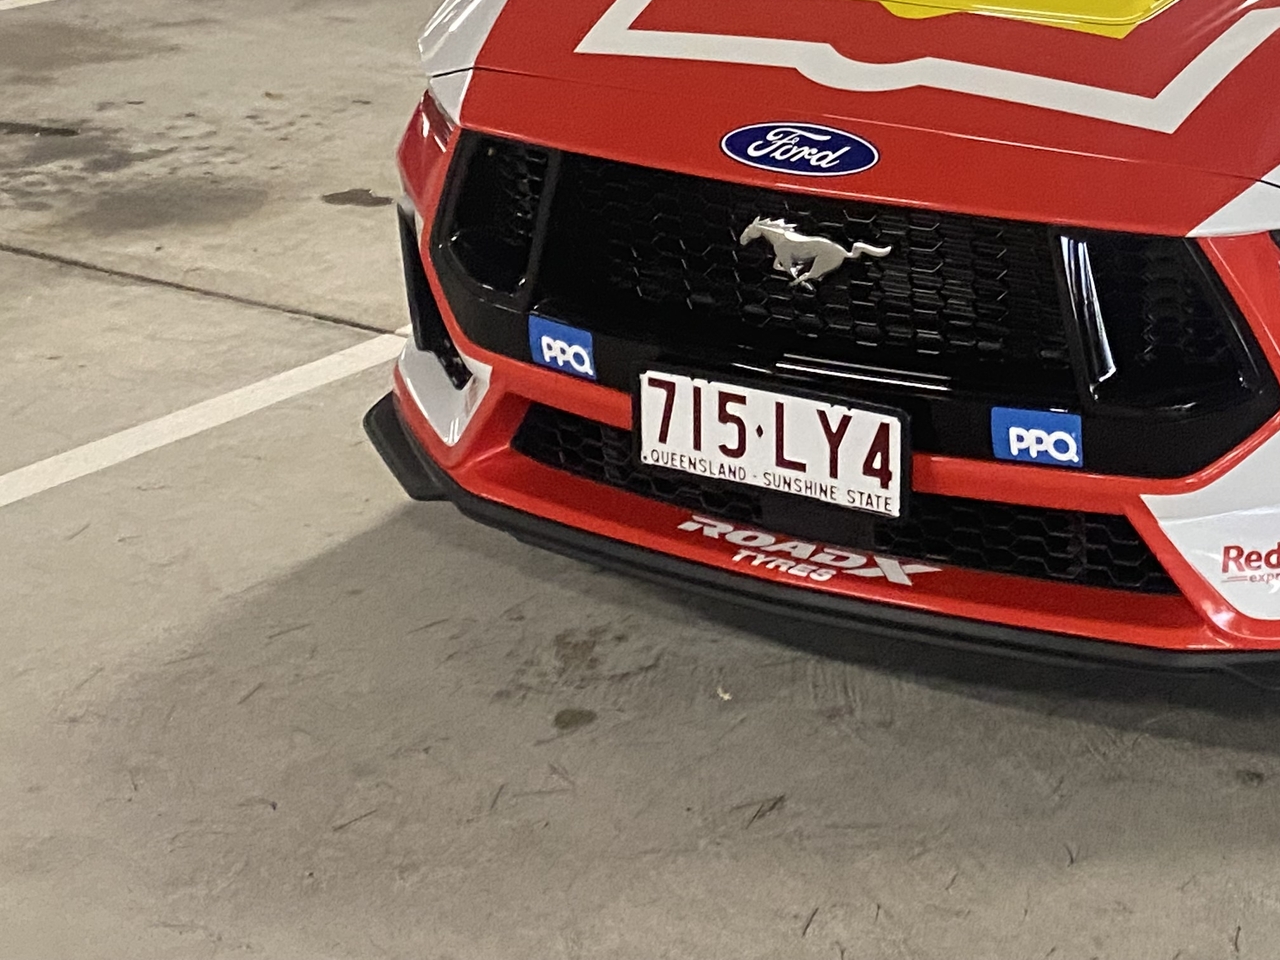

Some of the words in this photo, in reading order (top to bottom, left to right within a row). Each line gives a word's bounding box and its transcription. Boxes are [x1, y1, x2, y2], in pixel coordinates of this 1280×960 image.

[747, 127, 852, 168] Ford
[541, 335, 594, 376] PPQ
[1009, 426, 1080, 463] PPQ
[650, 448, 747, 482] QUEENSLAND
[763, 472, 838, 501] SUNSHINE
[846, 489, 893, 513] STATE
[677, 515, 942, 586] ROADX
[731, 548, 837, 581] TYRES
